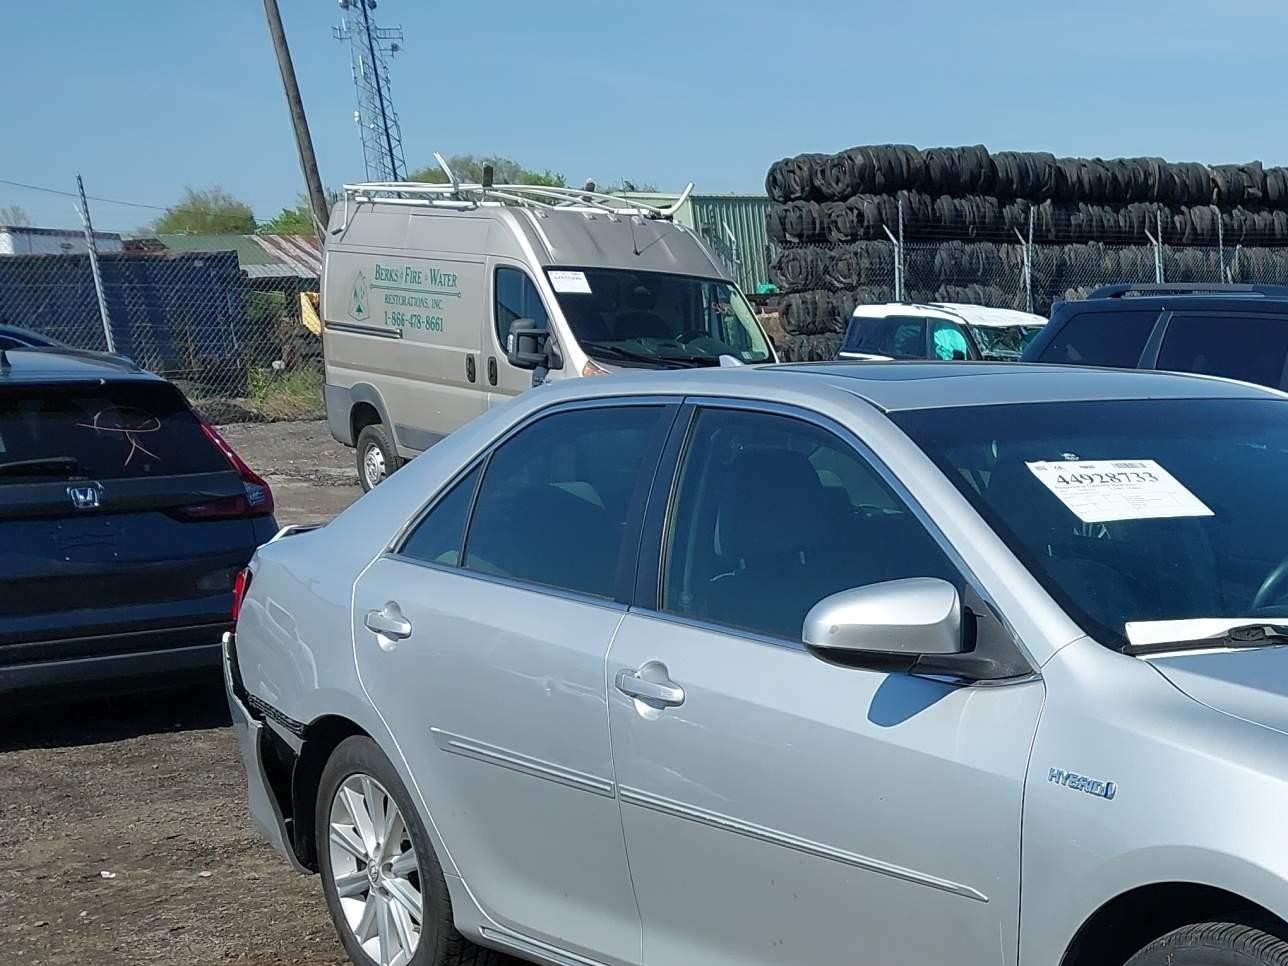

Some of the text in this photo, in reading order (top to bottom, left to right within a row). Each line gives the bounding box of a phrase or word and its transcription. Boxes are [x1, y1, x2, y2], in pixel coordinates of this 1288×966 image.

[375, 264, 457, 288] BERKS FIRE WATER
[384, 311, 444, 332] 1-866-478-8661
[1056, 471, 1160, 485] 44928733
[1047, 767, 1106, 798] HYBRID
